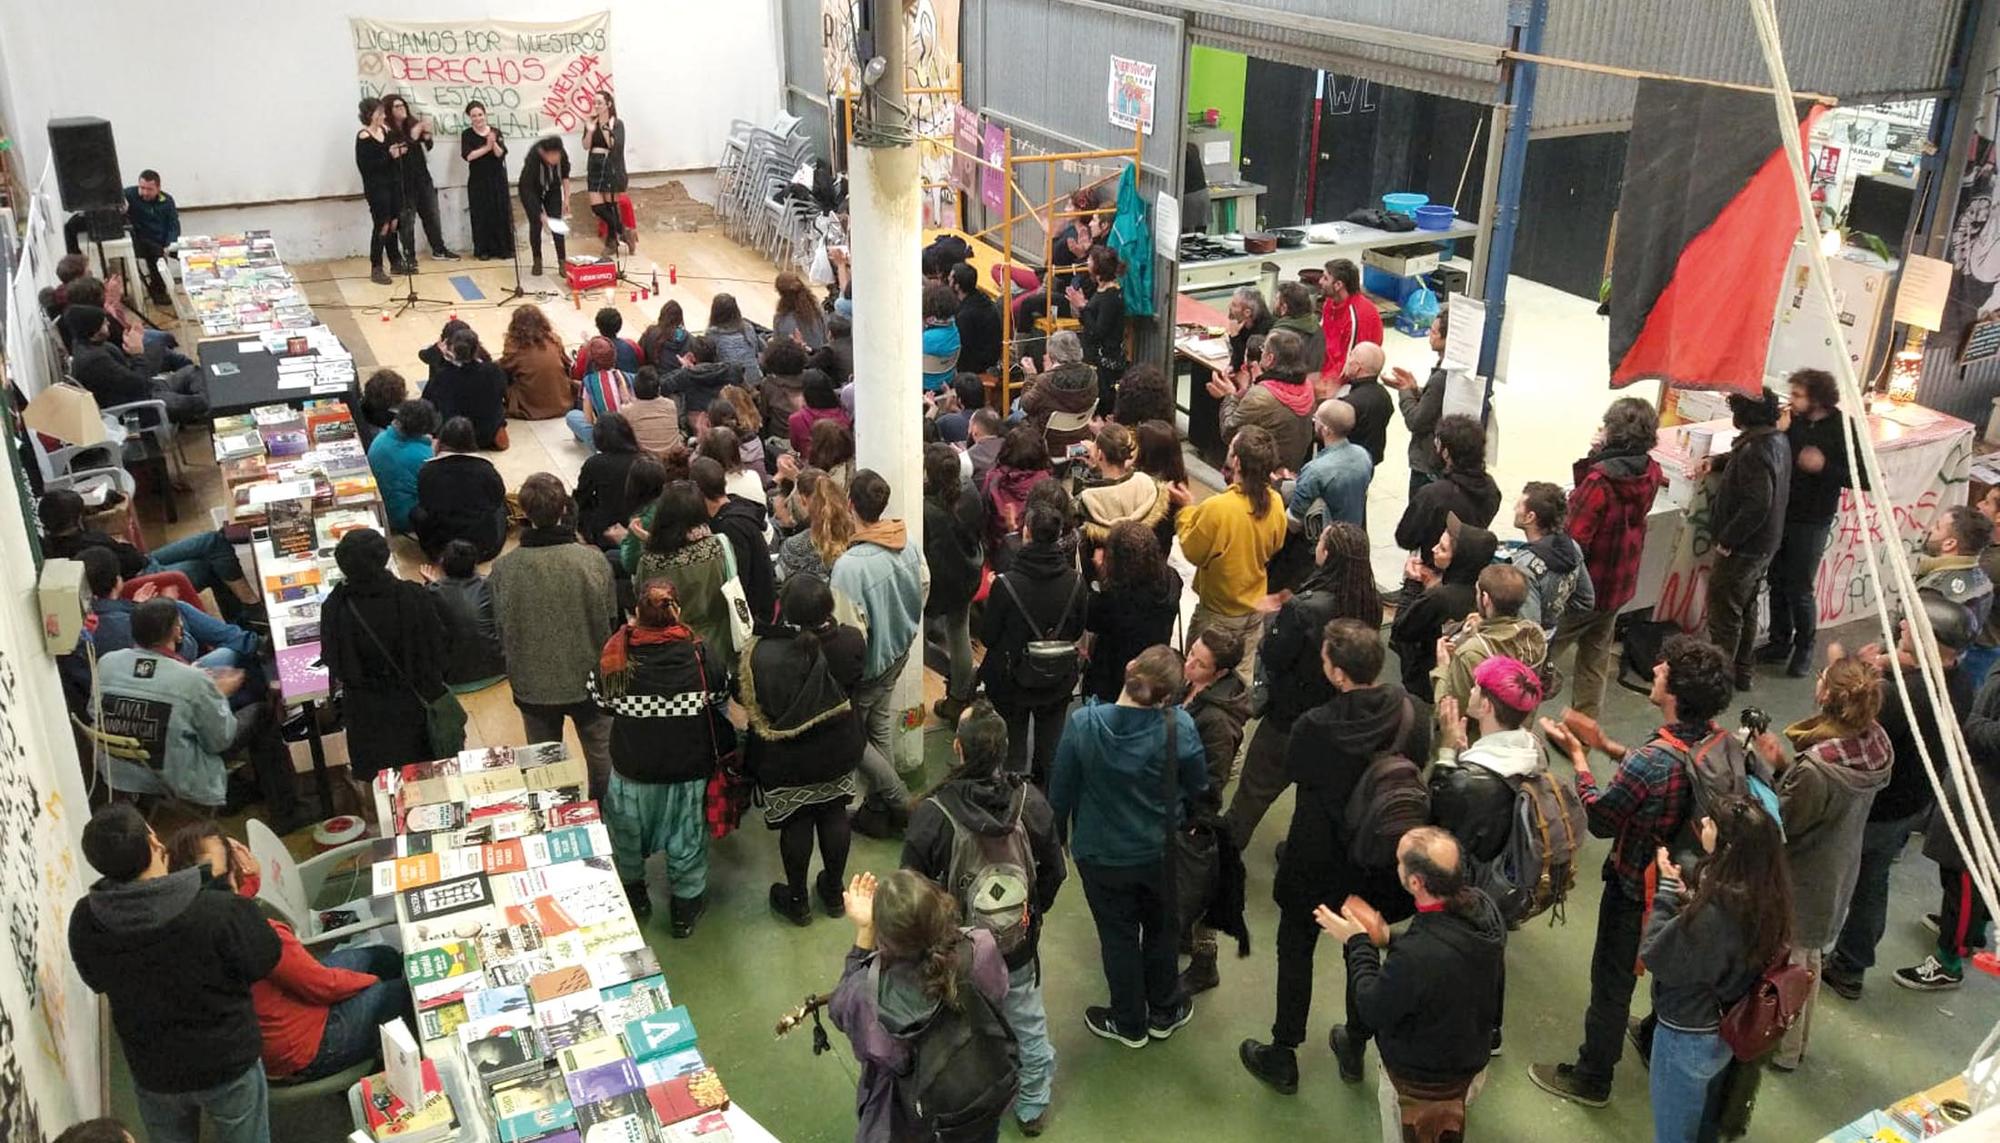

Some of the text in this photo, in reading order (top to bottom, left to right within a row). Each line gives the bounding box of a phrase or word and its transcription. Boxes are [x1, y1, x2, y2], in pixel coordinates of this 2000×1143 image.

[355, 26, 606, 55] LUCHAMOS POR NUESTROS
[387, 54, 545, 86] DERECHOS
[433, 85, 520, 109] ESTADO
